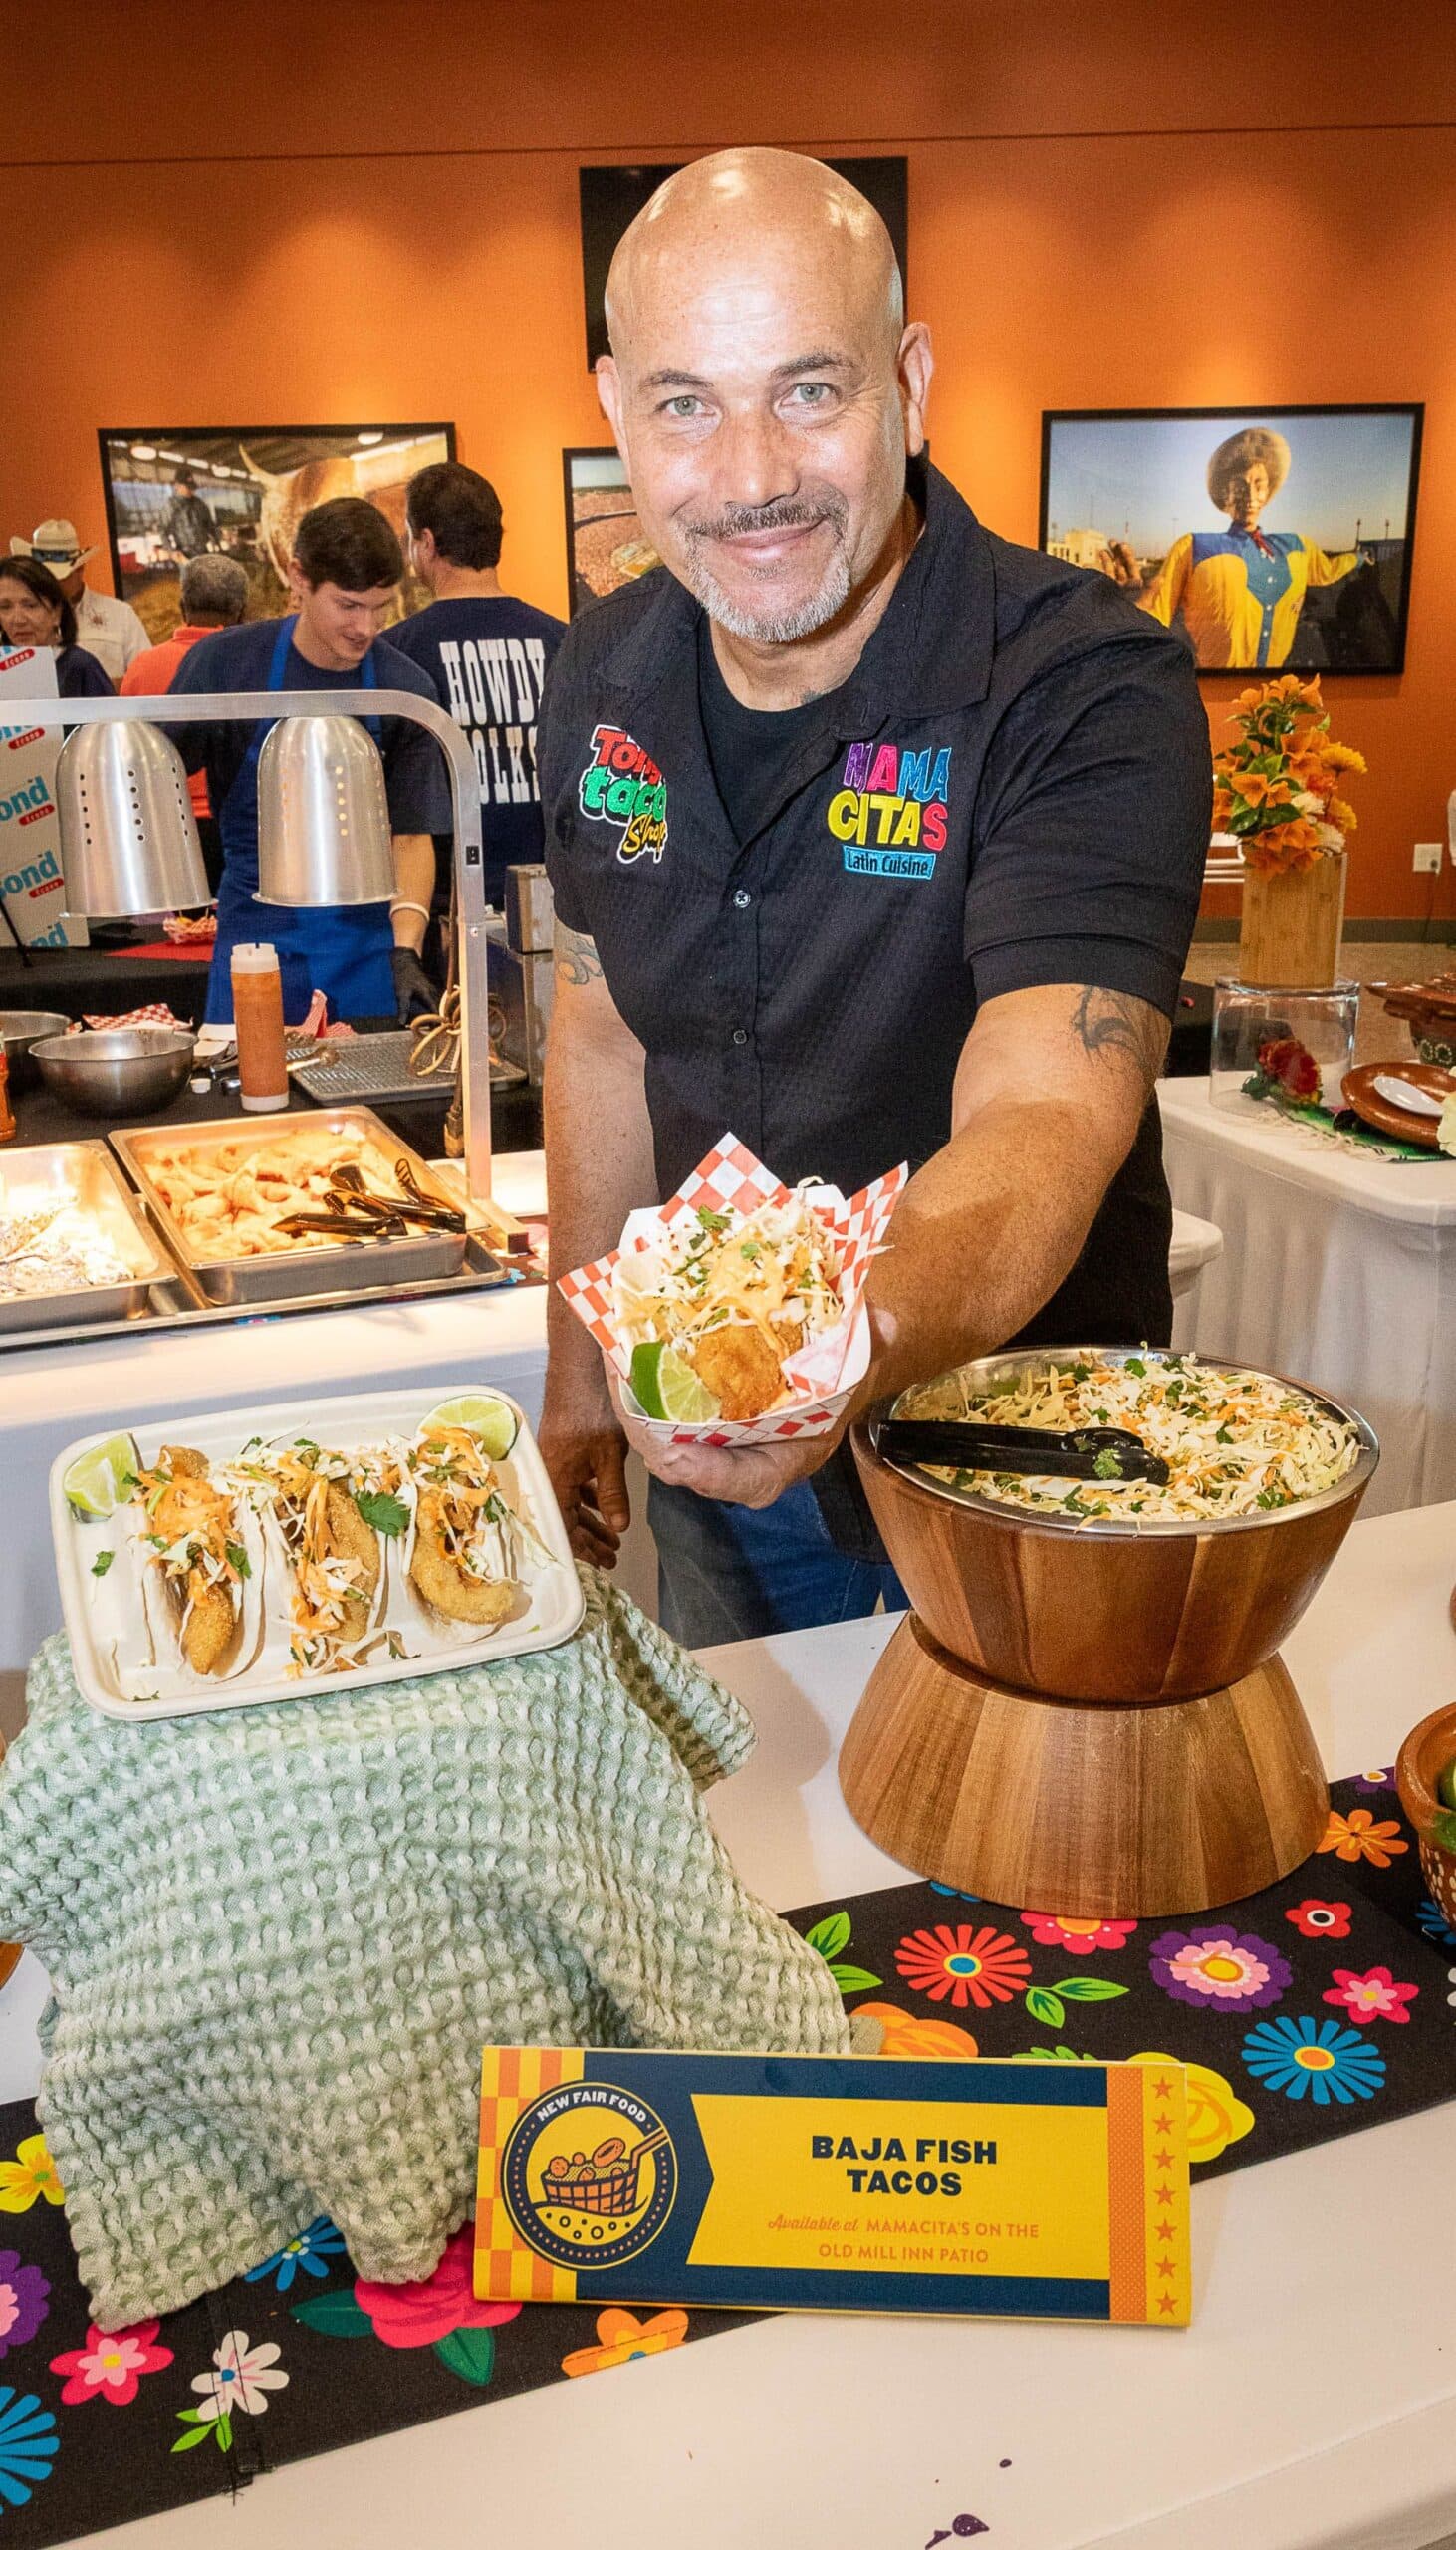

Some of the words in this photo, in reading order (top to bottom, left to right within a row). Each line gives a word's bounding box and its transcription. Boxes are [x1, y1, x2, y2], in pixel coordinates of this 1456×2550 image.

[439, 638, 546, 726] HOWDY
[471, 725, 542, 805] OLK
[584, 765, 666, 822] taco
[828, 790, 948, 852] CITAS
[0, 850, 60, 898] ond
[847, 850, 877, 872] Latin
[881, 854, 929, 877] Cuisine
[536, 2095, 570, 2122] NEW
[573, 2091, 607, 2104] FAIR
[608, 2095, 647, 2123] FOOD
[812, 2135, 907, 2162] BAJA
[915, 2139, 997, 2165] FISH
[847, 2169, 962, 2197] TACOS
[768, 2213, 841, 2232] Available
[844, 2217, 860, 2232] at
[866, 2218, 970, 2236] MAMACITA'S
[975, 2222, 1001, 2238] ON
[1007, 2223, 1040, 2239] THE
[819, 2243, 853, 2259] OLD
[858, 2245, 897, 2261] MILL
[902, 2246, 934, 2262] INN
[939, 2248, 989, 2264] PATIO
